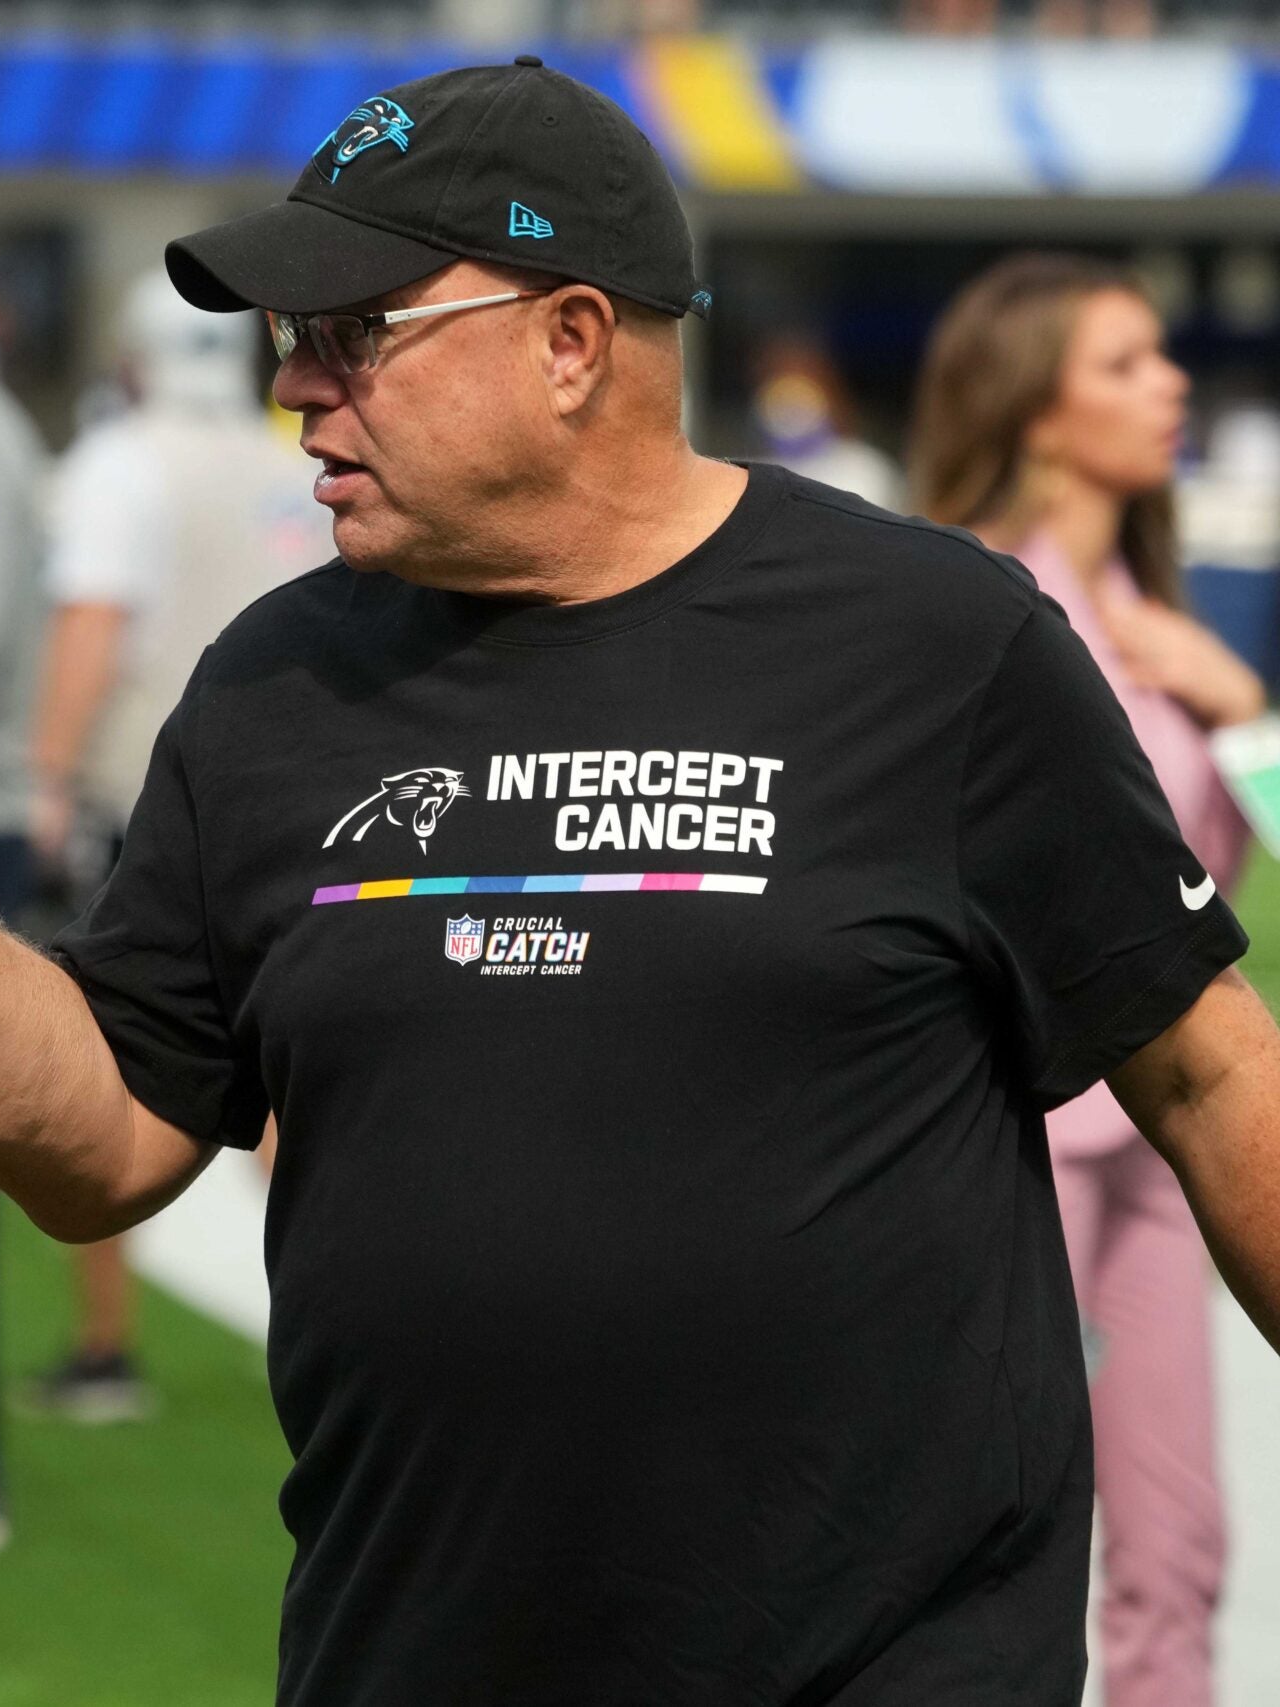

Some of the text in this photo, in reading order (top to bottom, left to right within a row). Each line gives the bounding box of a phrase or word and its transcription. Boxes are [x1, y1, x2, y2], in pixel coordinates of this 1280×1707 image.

[487, 750, 784, 803] INTERCEPT
[555, 803, 775, 856] CANCER
[493, 917, 563, 931] CRUCIAL
[450, 936, 478, 957] NFL
[486, 932, 590, 962] CATCH
[480, 965, 581, 976] INTERCEPT CANCER
